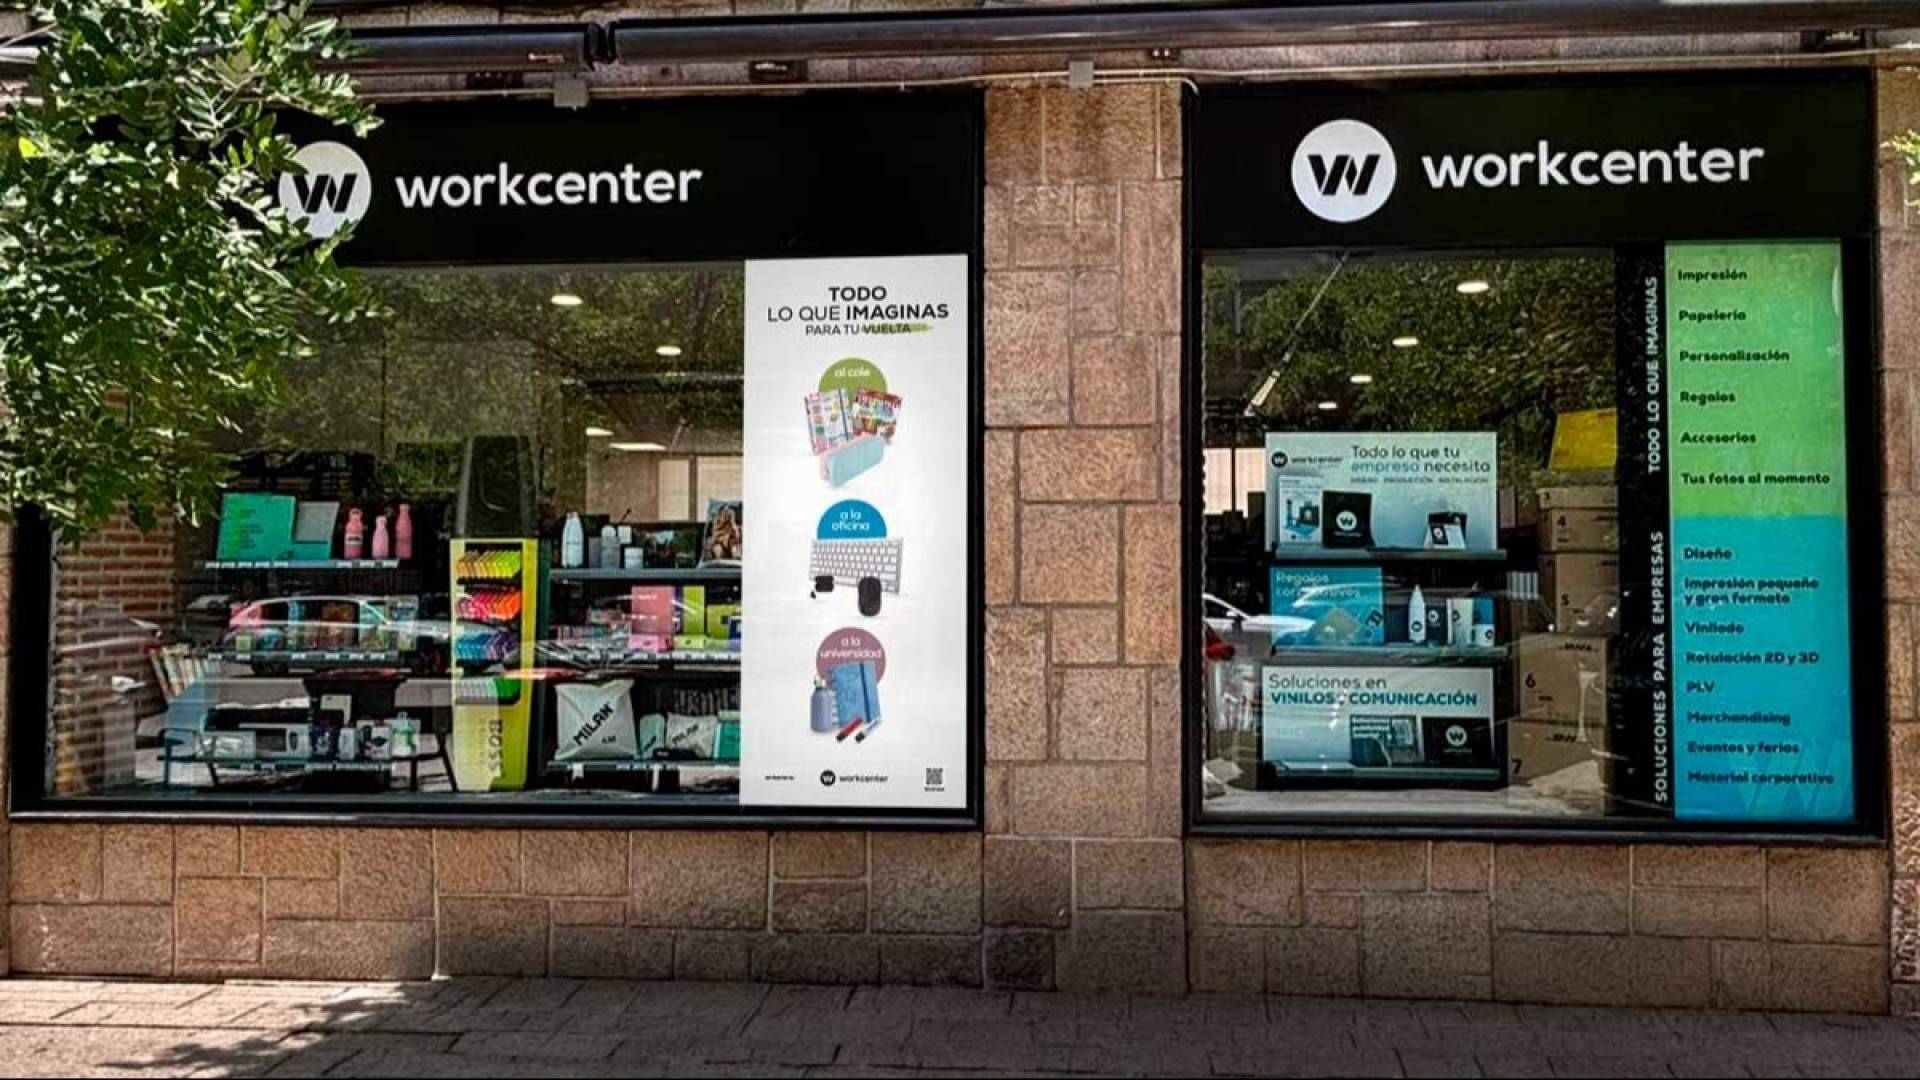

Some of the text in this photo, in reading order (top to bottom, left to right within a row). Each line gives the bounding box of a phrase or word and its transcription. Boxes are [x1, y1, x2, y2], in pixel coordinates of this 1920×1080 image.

[1421, 139, 1765, 189] workcenter
[395, 162, 702, 208] workcenter
[1678, 268, 1748, 283] Impresión
[828, 286, 887, 302] TODO
[767, 303, 949, 322] LO QUE IMAGINAS
[1678, 309, 1747, 323] Papelería
[805, 323, 912, 336] PARA TU VUELTA
[1679, 349, 1790, 362] Personalización
[834, 366, 871, 377] al cole
[1645, 276, 1661, 473] TODO LO QUE IMAGINAS
[1679, 391, 1736, 406] Regalos
[1680, 432, 1756, 444] Accesorios
[1351, 445, 1460, 462] Todo lo que tu
[1351, 459, 1491, 475] empresa necesita
[1681, 473, 1830, 484] Tus fotos al momento
[839, 509, 861, 520] a la
[1556, 515, 1567, 527] 4
[832, 520, 870, 531] oficina
[1684, 547, 1732, 560] Diseño
[1276, 571, 1329, 588] Regalos
[1684, 577, 1819, 591] Impresión pequeño
[1685, 595, 1693, 606] y
[1732, 592, 1790, 605] formato
[841, 636, 861, 647] a la
[820, 648, 882, 659] universidad
[1686, 651, 1819, 666] Rotulación 2D y 3D
[1650, 531, 1668, 803] SOLUCIONES PARA EMPRESAS
[1268, 673, 1387, 689] Soluciones en
[1525, 673, 1536, 689] 6
[1686, 681, 1715, 693] PLV
[1271, 691, 1335, 705] VINILOS
[1349, 690, 1478, 706] COMUNICACIÓN
[573, 703, 614, 746] MILAN
[1687, 711, 1791, 727] Merchandising
[1688, 741, 1799, 756] Eventos y ferias
[1511, 760, 1522, 775] 7
[839, 774, 889, 783] workcenter
[1688, 772, 1835, 785] Material corporativo
